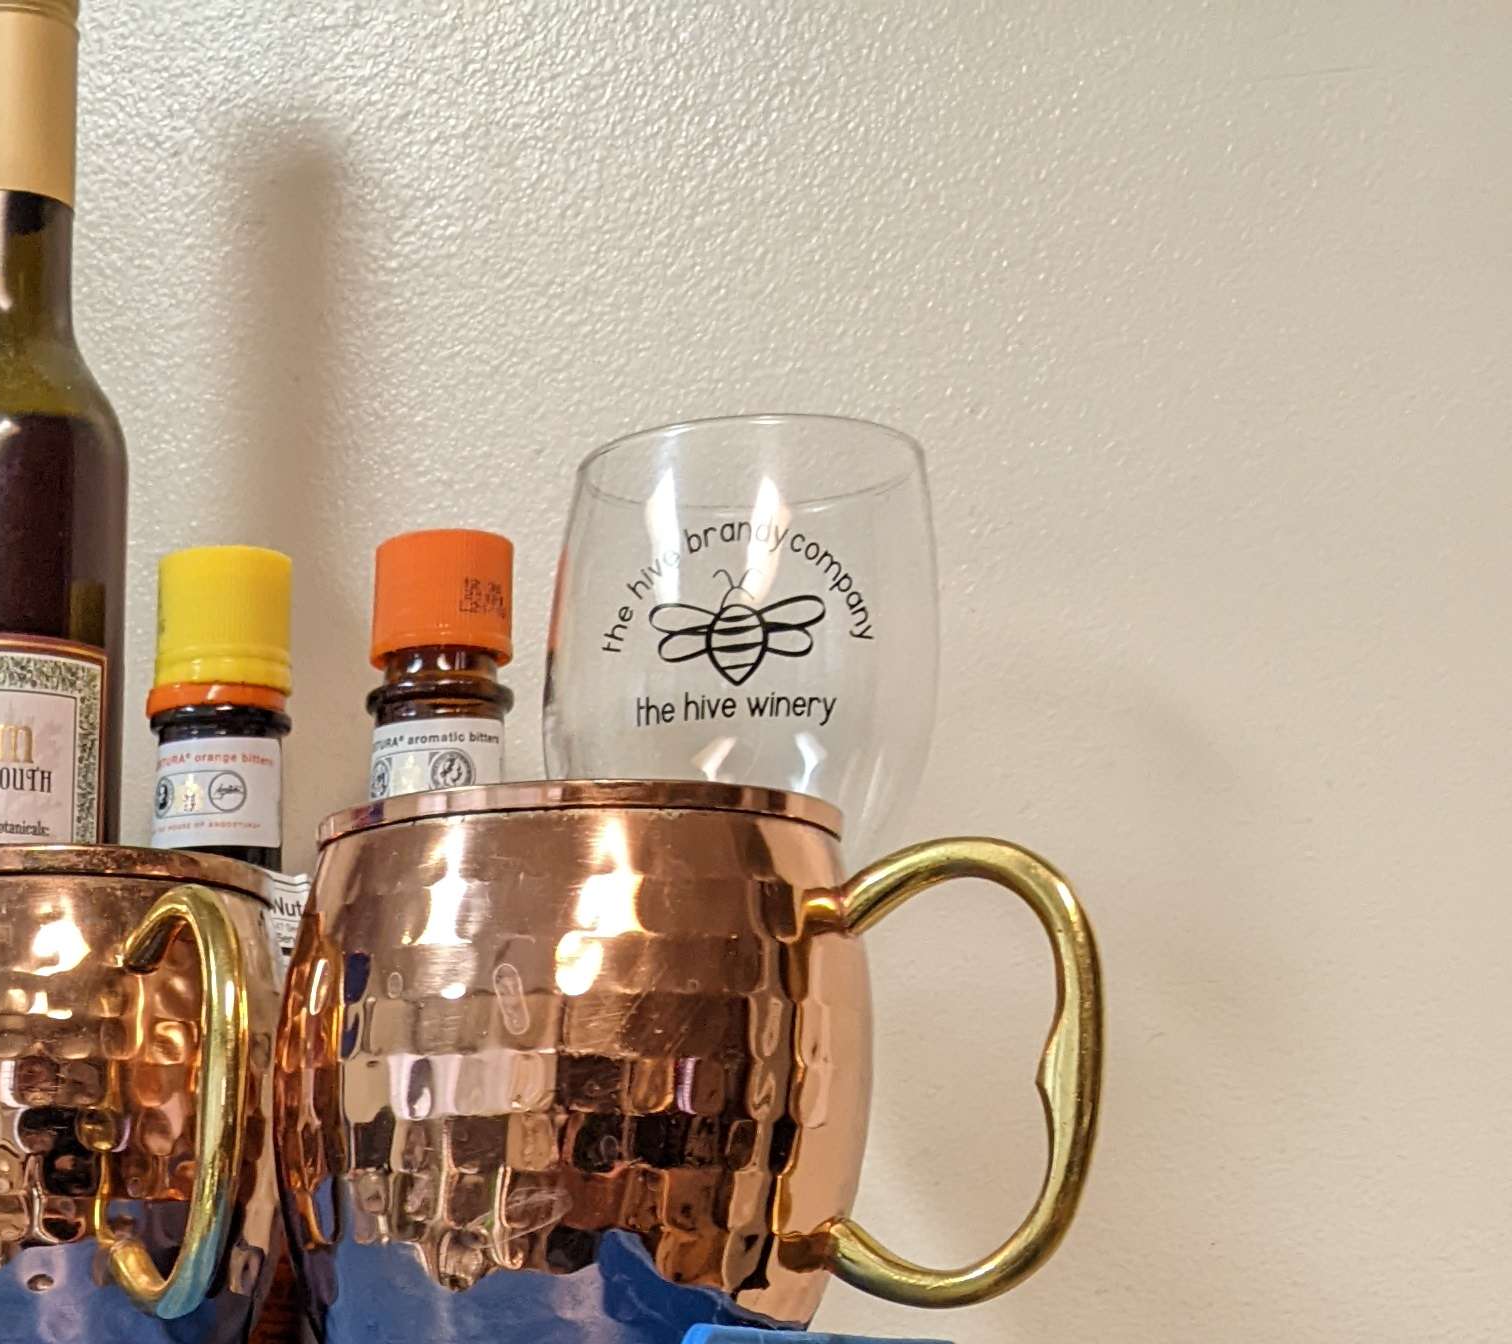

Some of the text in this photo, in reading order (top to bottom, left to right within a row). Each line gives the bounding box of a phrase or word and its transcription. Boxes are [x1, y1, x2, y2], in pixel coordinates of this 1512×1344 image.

[602, 521, 875, 652] the hive brandy company
[636, 692, 836, 727] the hive winery
[407, 731, 465, 745] aromatic
[469, 731, 500, 745] bitters
[194, 752, 237, 764] orange
